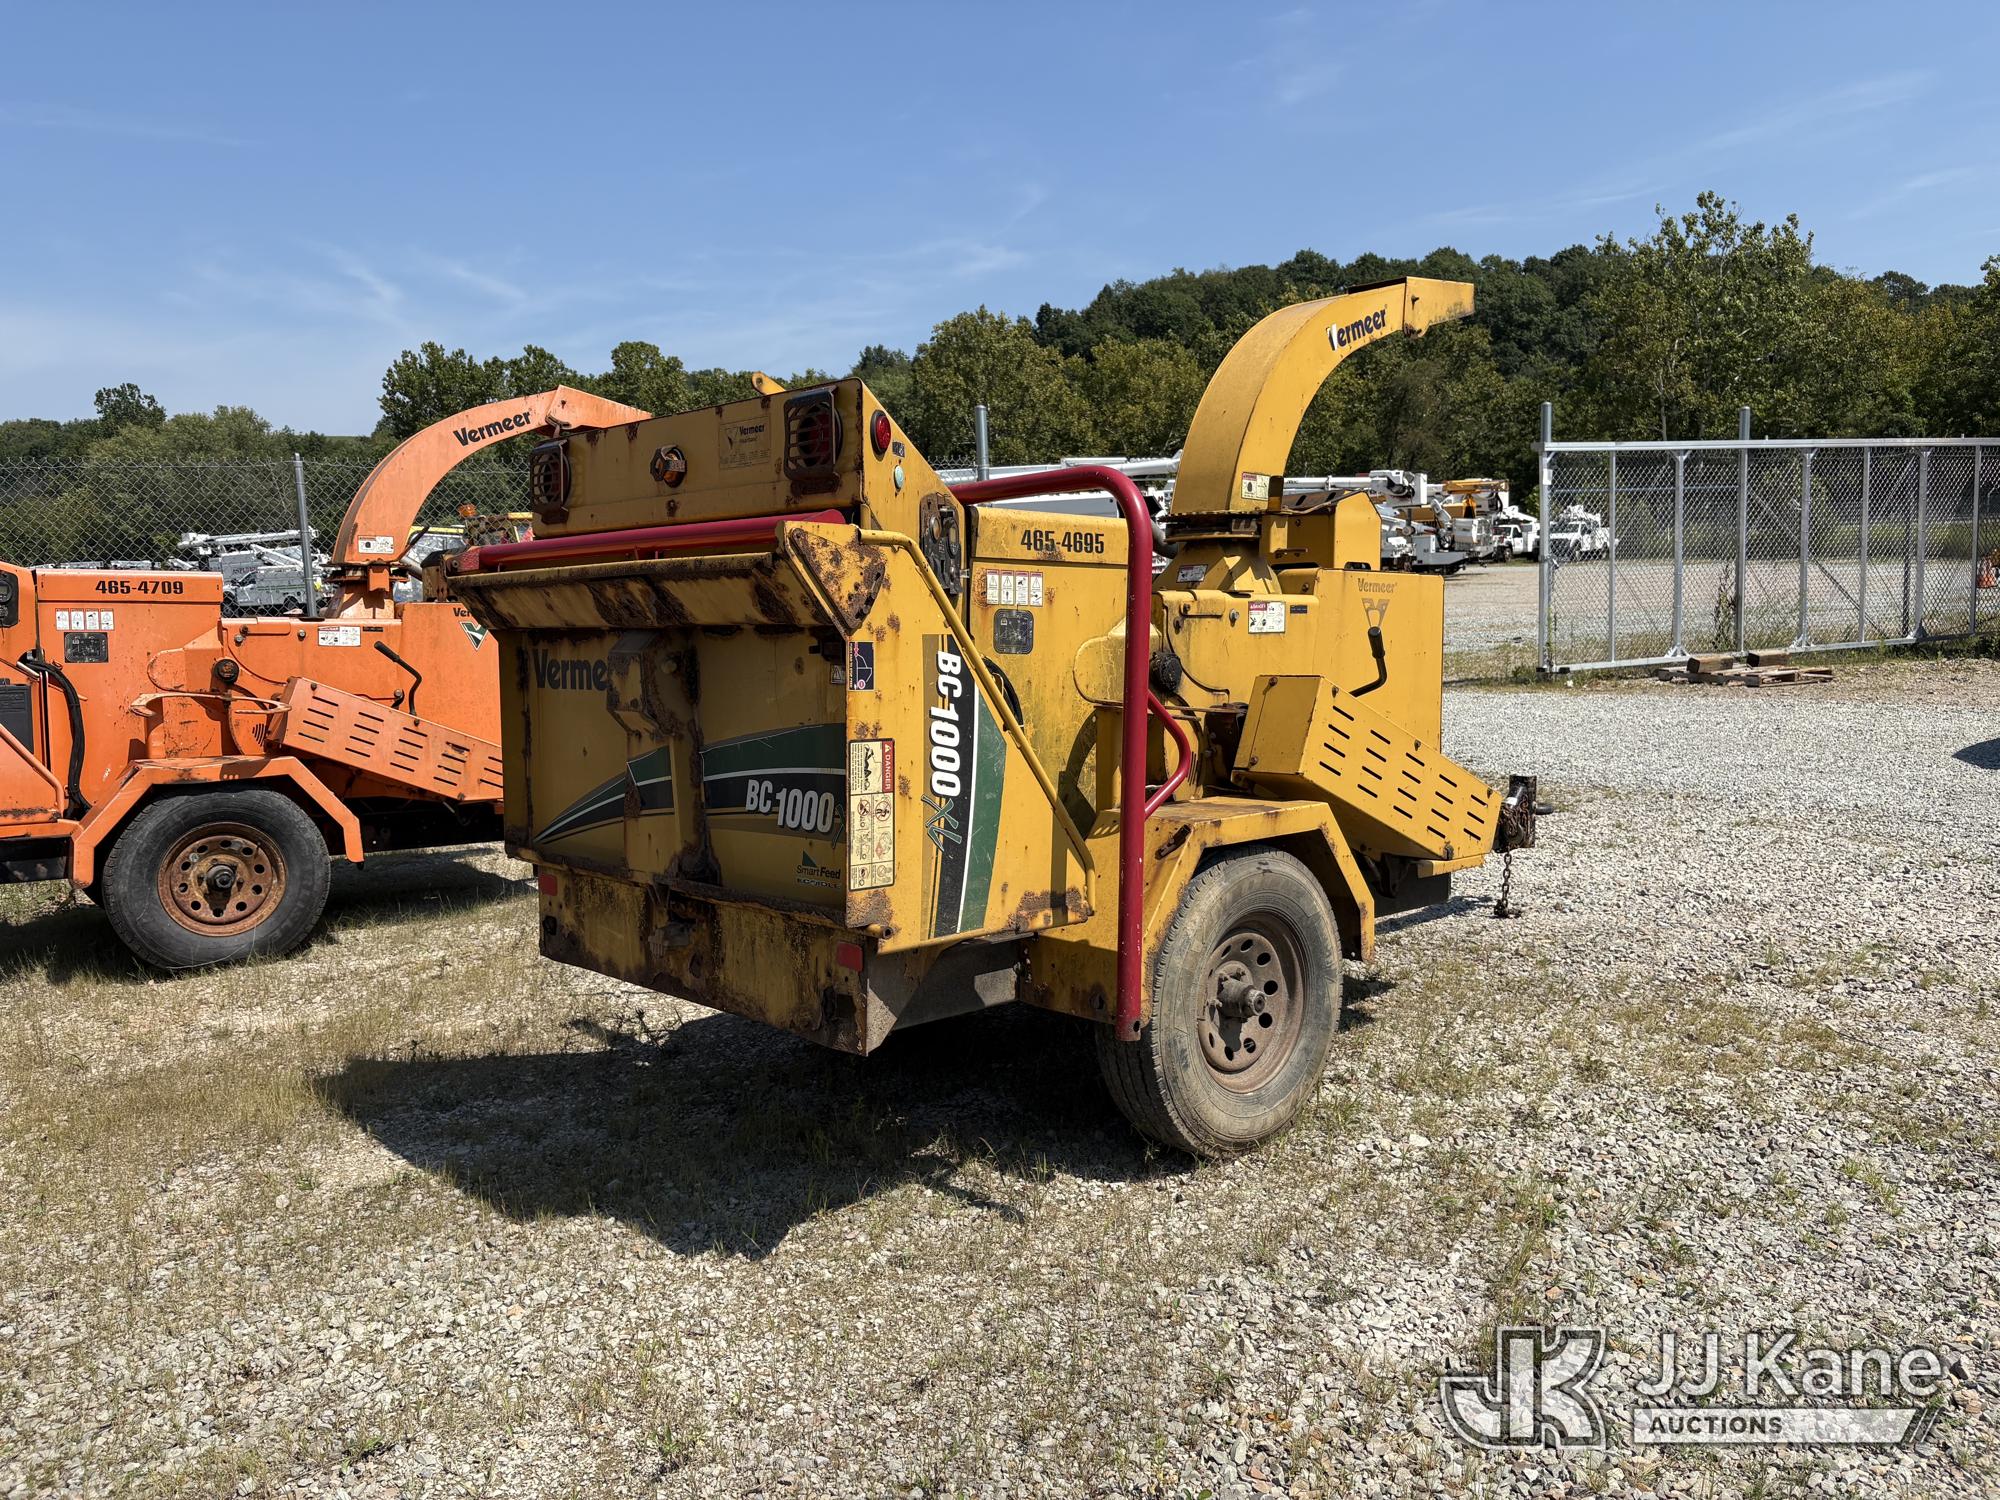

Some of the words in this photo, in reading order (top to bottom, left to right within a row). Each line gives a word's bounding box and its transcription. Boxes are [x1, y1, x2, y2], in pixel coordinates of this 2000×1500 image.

[453, 411, 532, 447] Vermeer
[1020, 529, 1105, 554] 465-4695
[95, 580, 184, 595] 465-4709
[533, 648, 608, 692] Verme
[883, 754, 892, 790] DANGER
